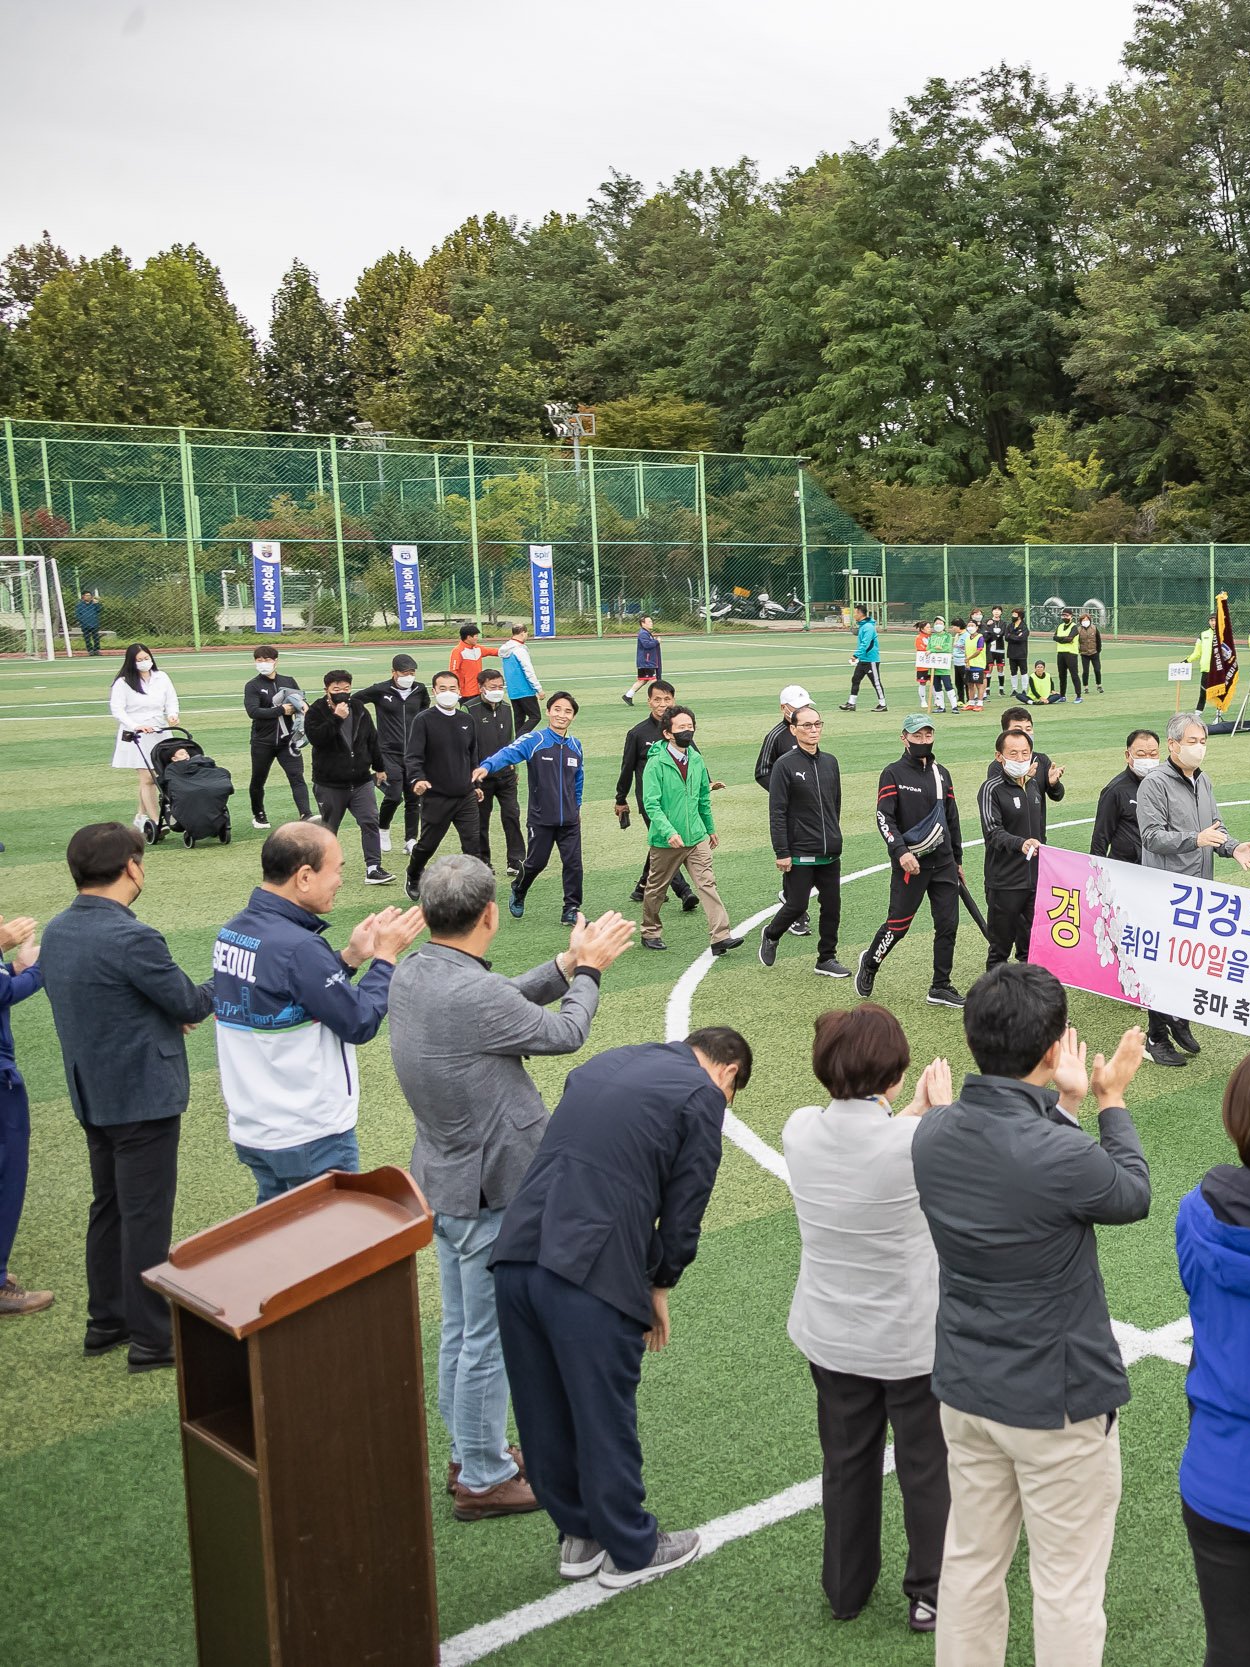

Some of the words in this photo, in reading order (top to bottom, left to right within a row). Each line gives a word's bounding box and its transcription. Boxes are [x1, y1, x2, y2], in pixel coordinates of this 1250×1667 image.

[261, 565, 276, 630] 광장축구회
[401, 567, 418, 629] 중곡축구회
[537, 570, 551, 633] 서울프라임병원
[236, 933, 261, 951] LEADER
[1046, 886, 1081, 949] 경
[213, 940, 257, 984] SEOUL
[1121, 925, 1160, 962] 취임
[1168, 937, 1249, 984] 100일을
[1193, 988, 1228, 1018] 중마
